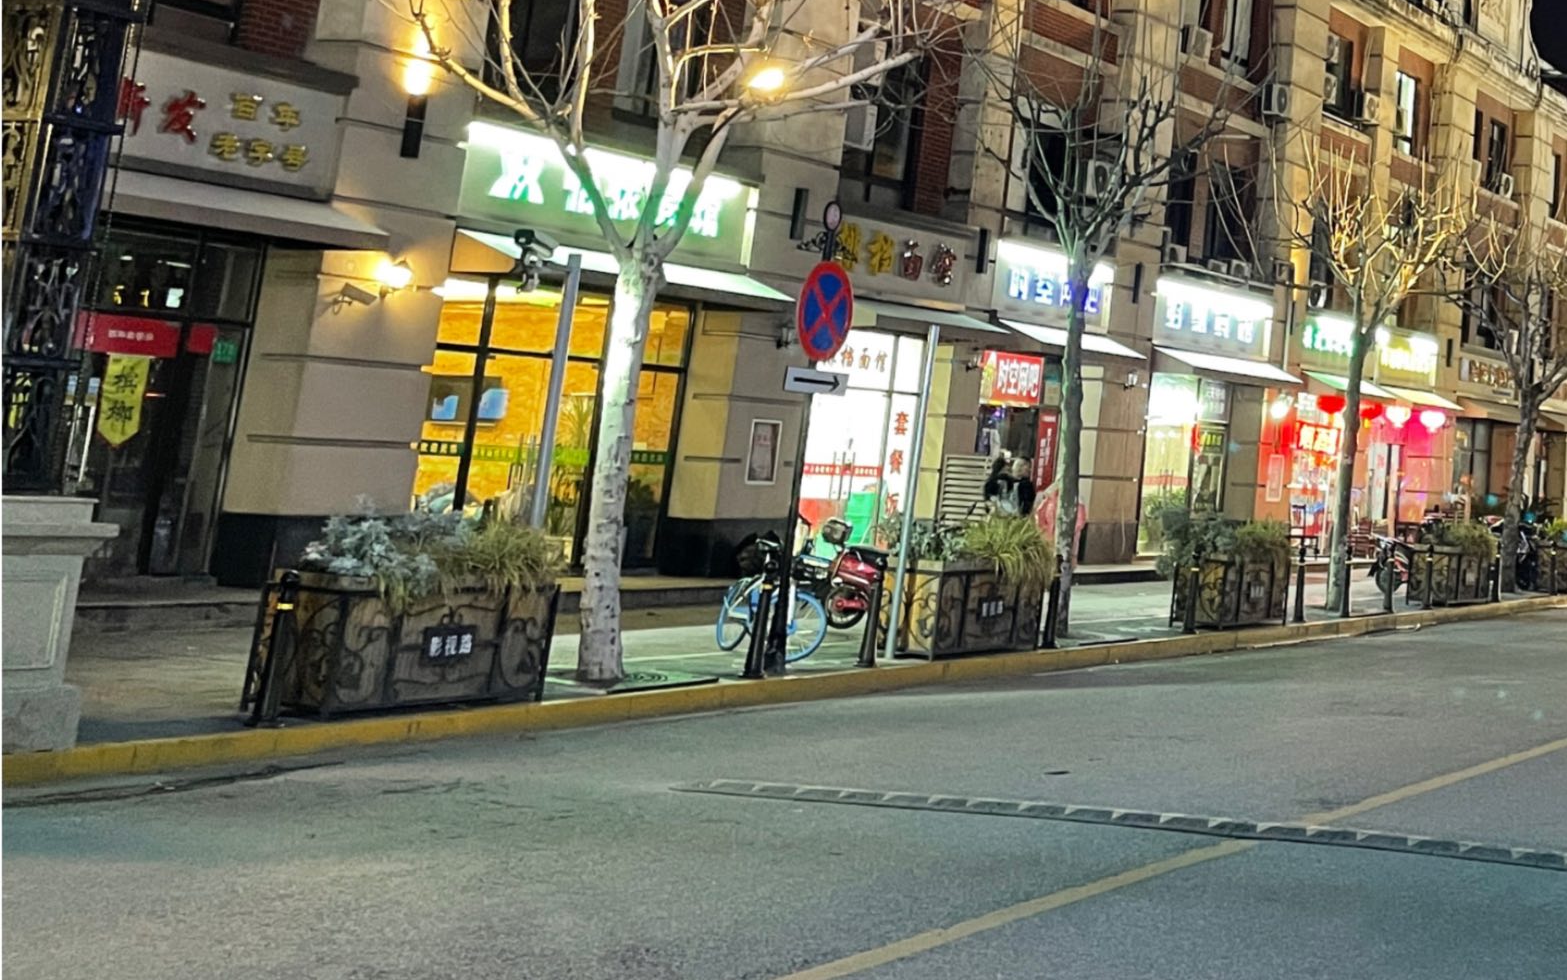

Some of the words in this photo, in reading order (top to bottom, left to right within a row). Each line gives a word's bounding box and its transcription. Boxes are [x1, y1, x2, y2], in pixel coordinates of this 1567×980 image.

[230, 91, 302, 131] 百年
[210, 131, 309, 171] 老字号
